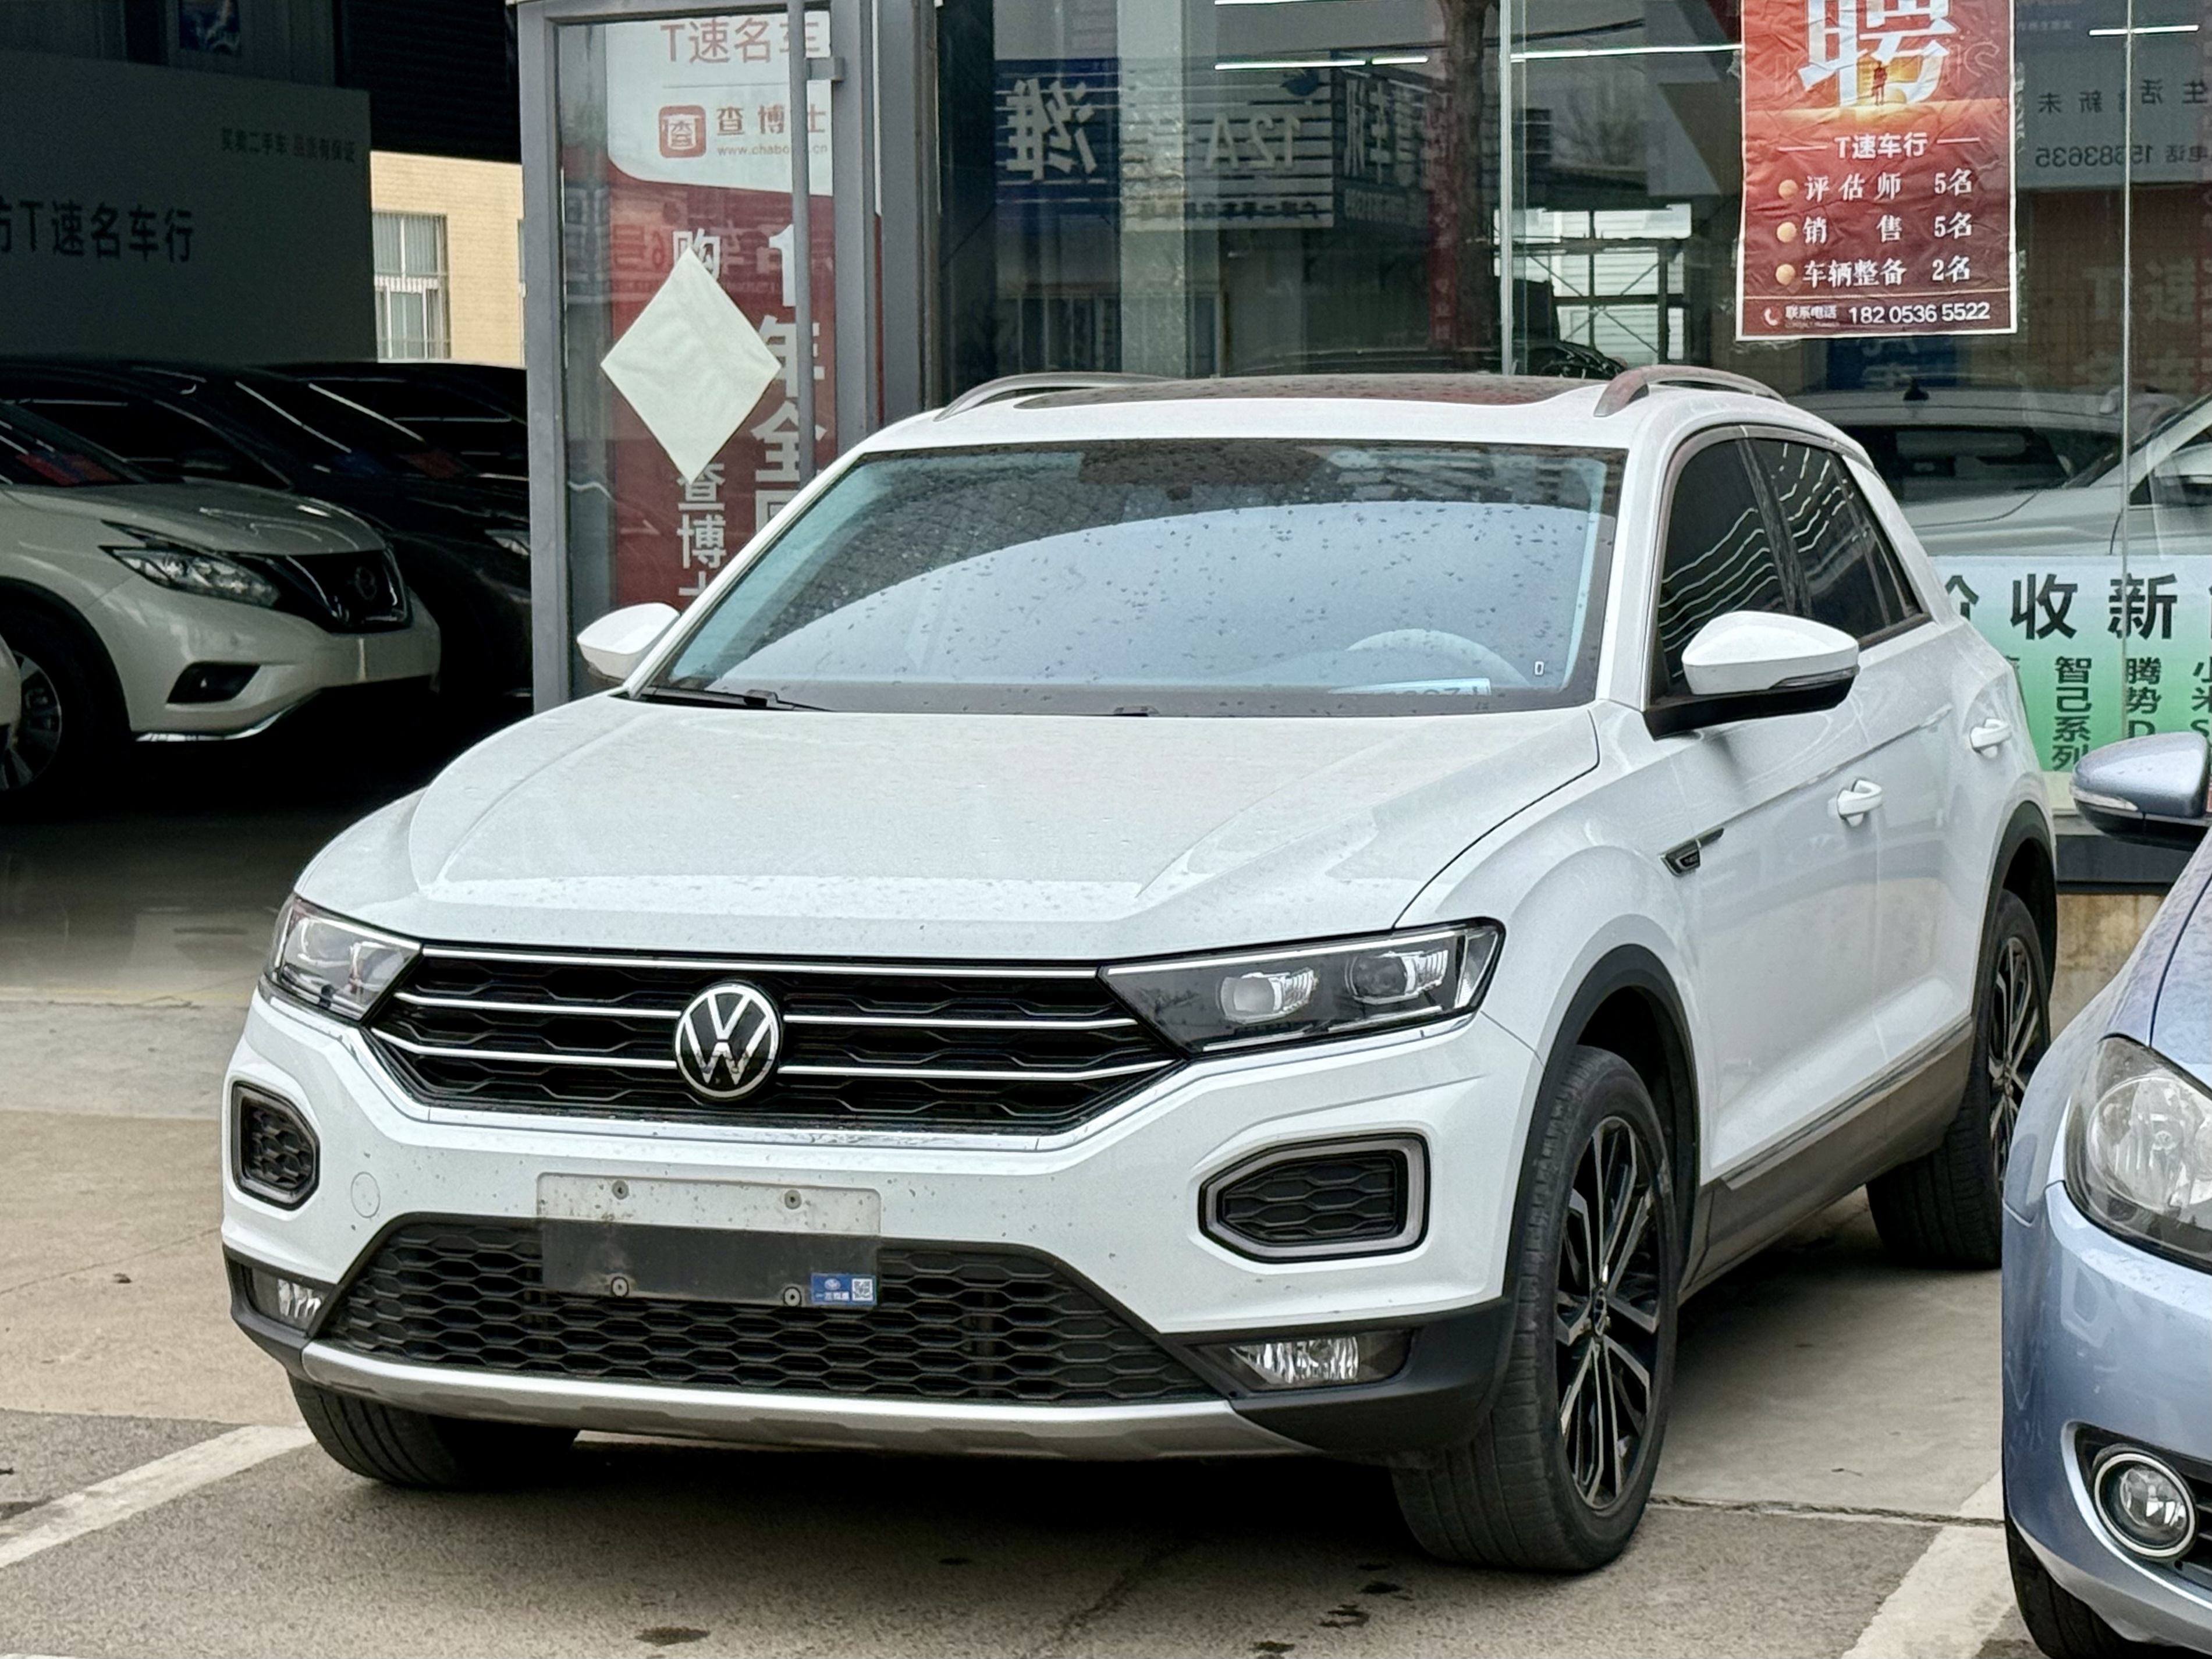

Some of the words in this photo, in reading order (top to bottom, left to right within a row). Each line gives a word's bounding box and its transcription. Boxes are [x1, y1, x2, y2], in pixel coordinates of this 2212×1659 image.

[1834, 132, 1929, 159] T速车行
[1805, 172, 1901, 202] 评估师
[1934, 168, 1973, 197] 5名
[1803, 215, 1903, 244] 销售
[1934, 211, 1973, 239] 5名
[1802, 258, 1907, 288] 车辆整备
[1931, 255, 1971, 283] 2名
[1848, 306, 1886, 325] 182
[1888, 304, 1937, 323] 0536
[1941, 301, 1991, 321] 5522
[2051, 656, 2093, 772] 智己系列
